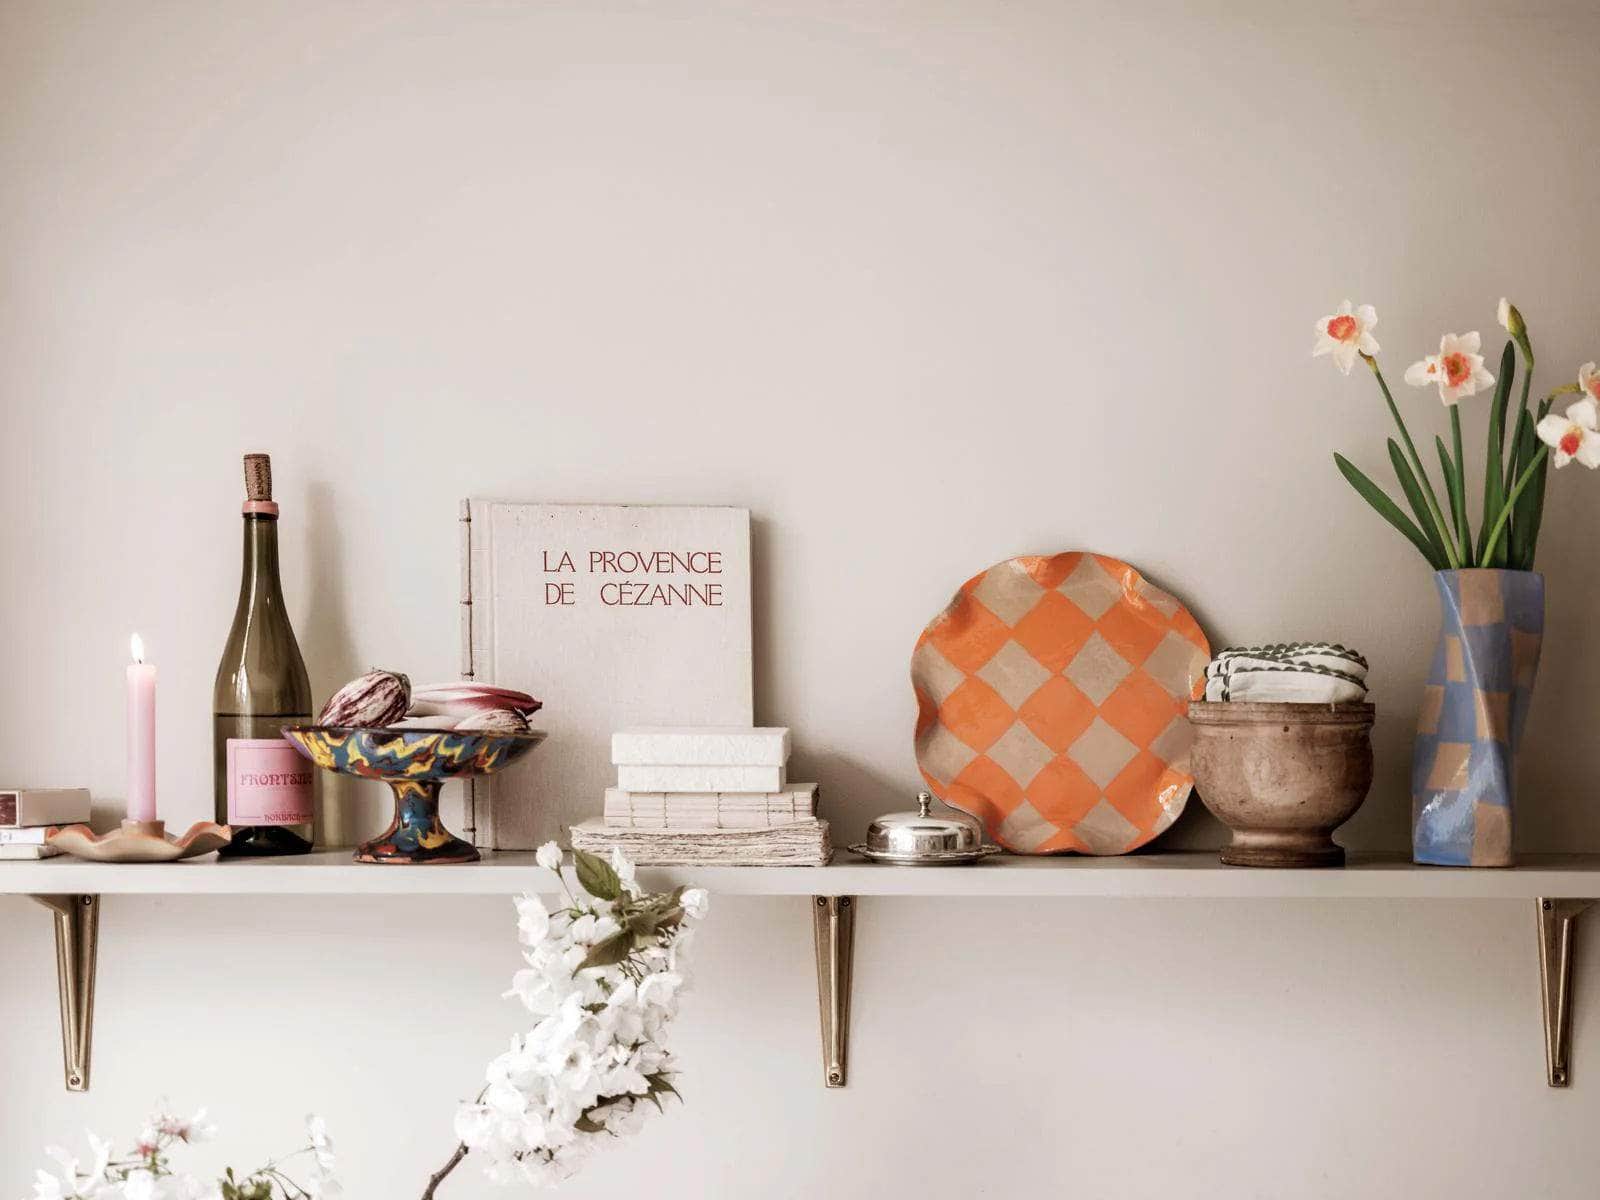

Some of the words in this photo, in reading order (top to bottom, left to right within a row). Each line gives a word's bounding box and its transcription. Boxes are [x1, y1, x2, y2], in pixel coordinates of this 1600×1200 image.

[543, 550, 576, 573] LA
[589, 550, 723, 574] PROVENCE
[545, 583, 576, 605] DE
[600, 580, 723, 606] CÉZANNE
